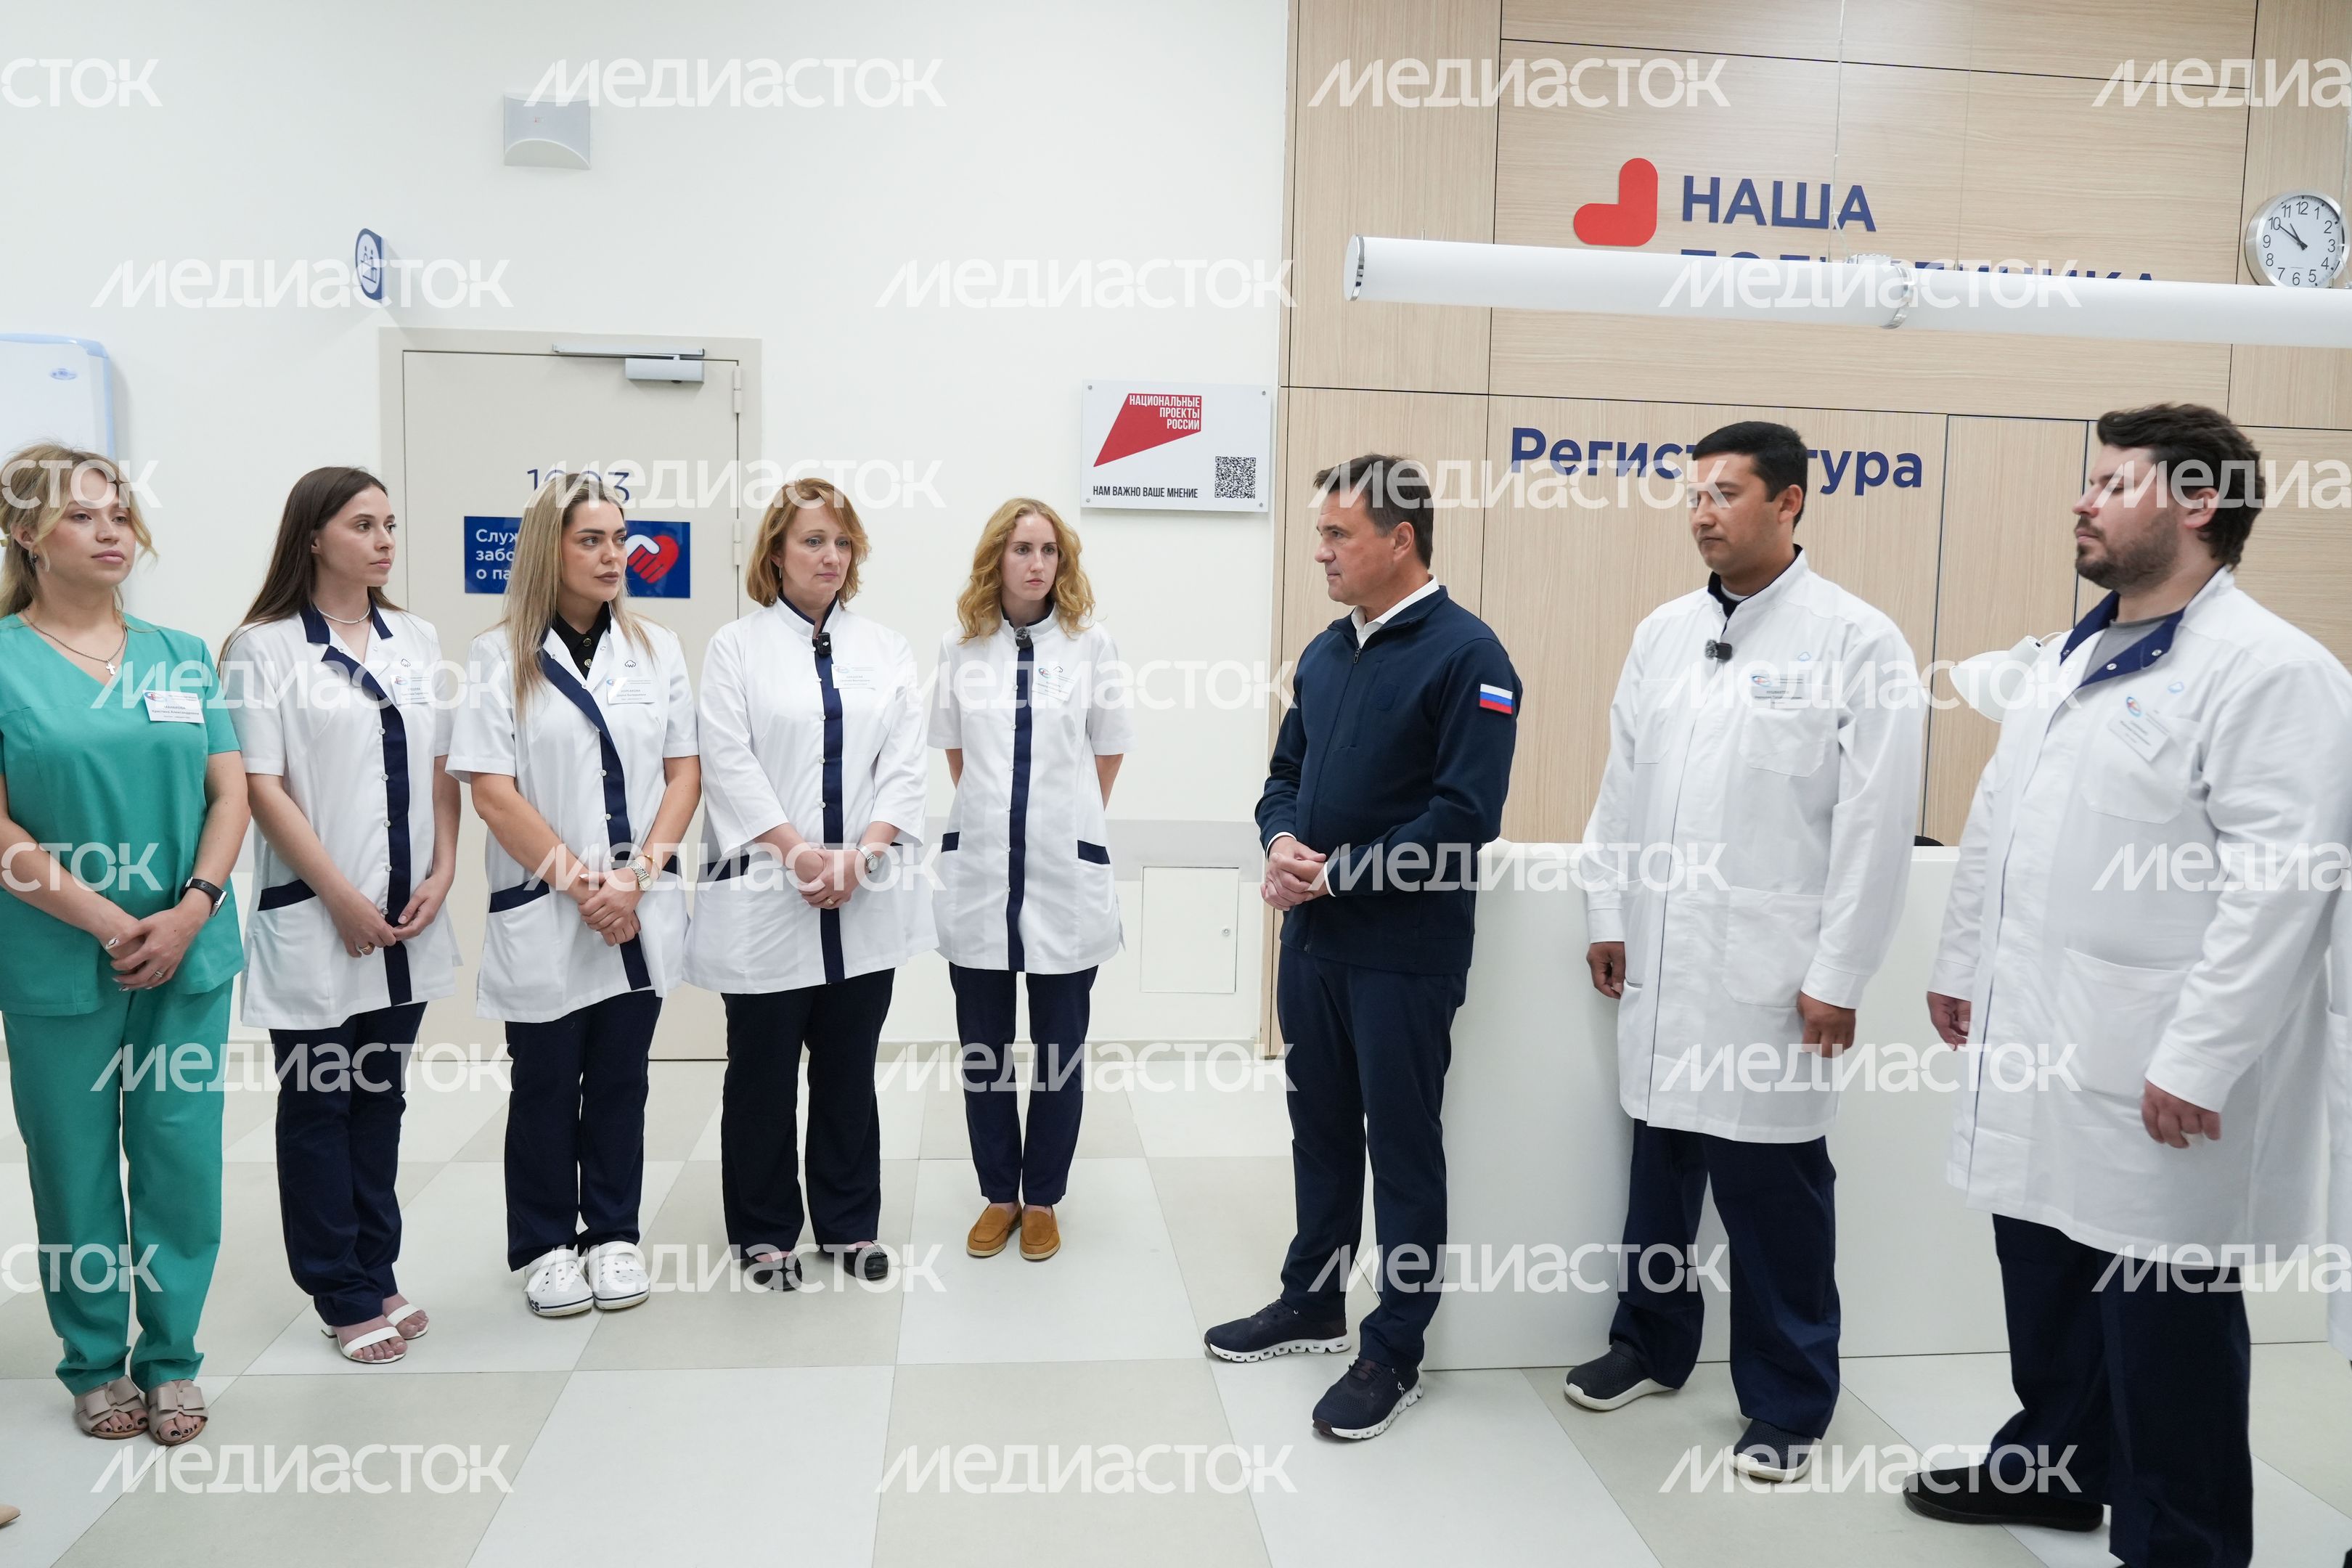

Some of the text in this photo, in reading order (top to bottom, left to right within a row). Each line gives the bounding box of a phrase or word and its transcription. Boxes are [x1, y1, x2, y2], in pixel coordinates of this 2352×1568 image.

[1682, 176, 1877, 232] НАША
[2296, 202, 2308, 215] 12
[2282, 205, 2291, 218] 11
[2314, 207, 2319, 220] 1
[2269, 217, 2281, 230] 10
[2324, 221, 2332, 234] 2
[2263, 234, 2271, 248] 9
[2328, 239, 2335, 253] 3
[2266, 253, 2274, 266] 8
[2322, 257, 2329, 270] 4
[2278, 267, 2285, 280] 7
[2292, 272, 2300, 285] 6
[2308, 269, 2316, 282] 5
[1129, 395, 1200, 407] НАЦИОНАЛЬНЫЕ
[1159, 407, 1200, 419] ПРОЕКТЫ
[1167, 419, 1200, 430] РОССИИ
[1511, 428, 1923, 495] Регисура
[1093, 486, 1199, 498] НАМ ВАЖНО ВАШЕ МНЕНИЕ
[475, 548, 515, 561] забо
[476, 569, 487, 579] о
